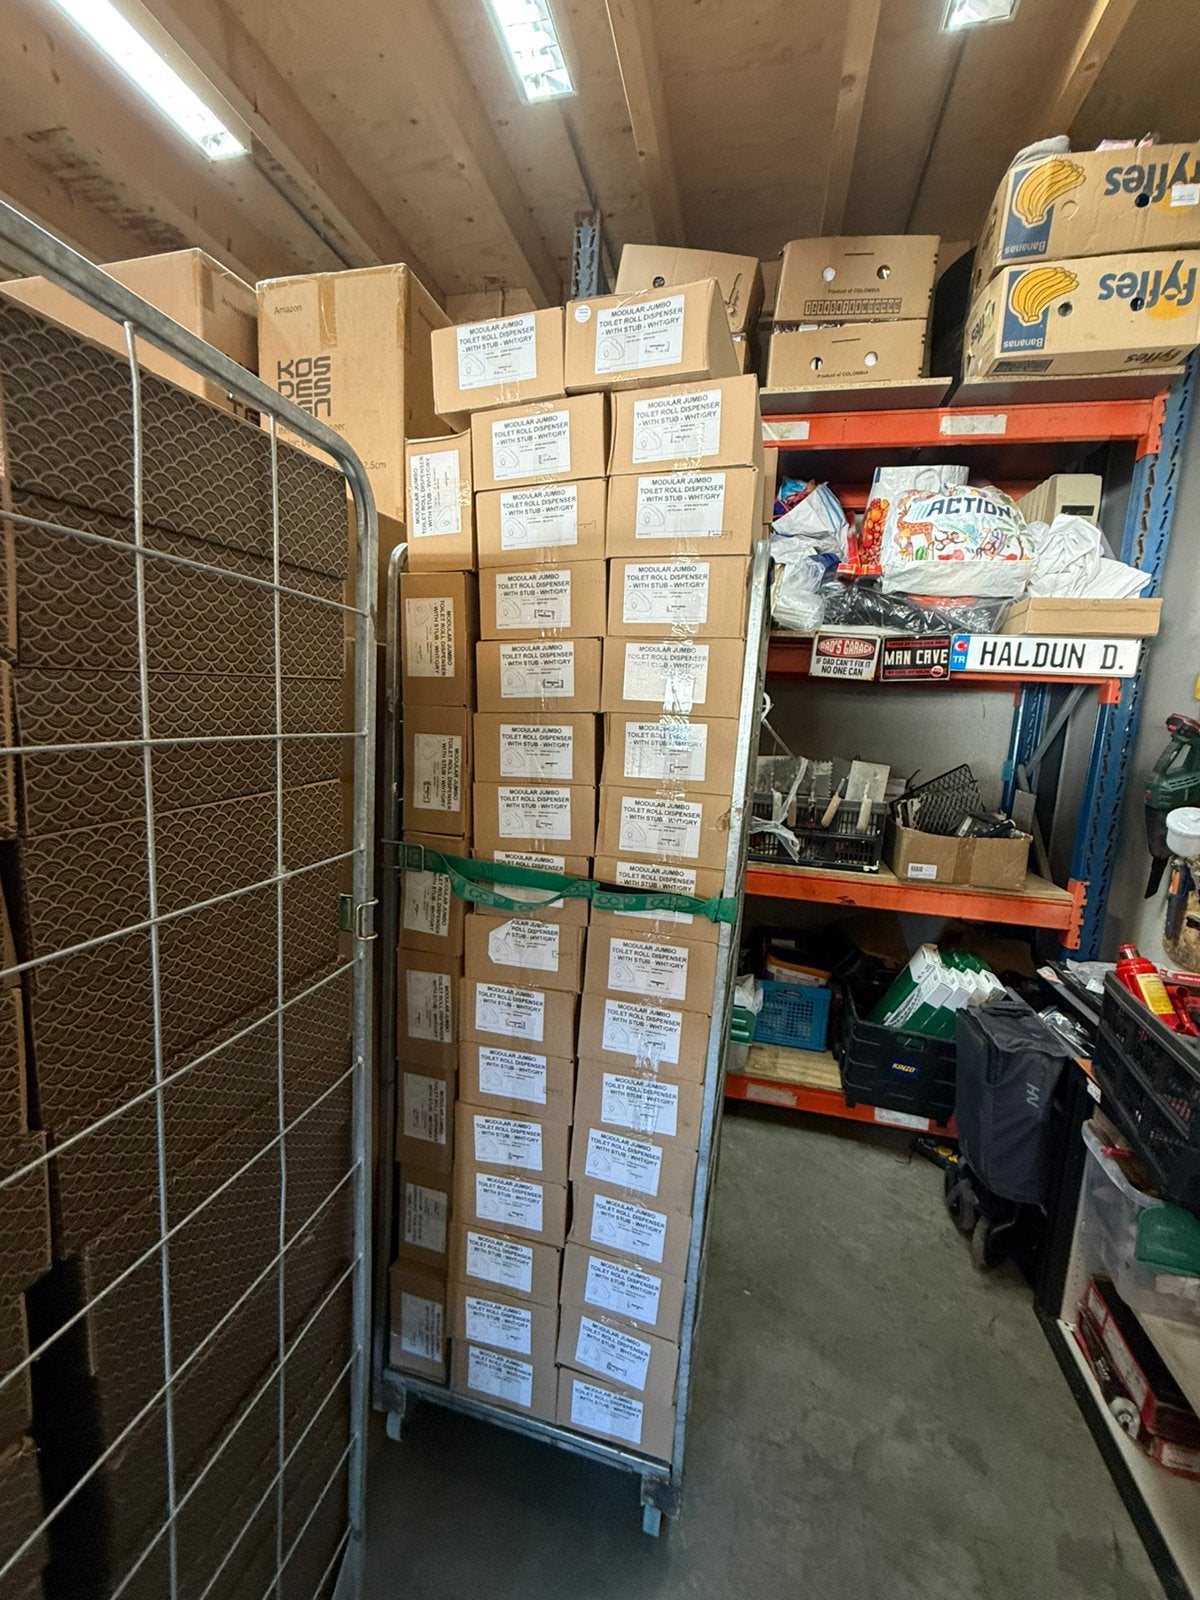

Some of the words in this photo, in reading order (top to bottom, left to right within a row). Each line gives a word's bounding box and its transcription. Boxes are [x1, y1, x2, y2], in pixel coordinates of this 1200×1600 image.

[1005, 241, 1046, 254] Bananas
[274, 304, 302, 314] Amazon
[611, 305, 644, 317] MODULAR
[646, 300, 671, 311] JUMBO
[599, 318, 622, 328] TOILET
[624, 314, 641, 323] ROLL
[643, 307, 682, 320] DISPENSER
[469, 323, 500, 334] MODULAR
[501, 320, 523, 329] JUMBO
[605, 327, 621, 335] WITH
[624, 323, 641, 332] STUB
[647, 316, 679, 328] WHT/GRY
[459, 335, 480, 344] TOILET
[482, 332, 497, 341] ROLL
[499, 326, 533, 338] DISPENSER
[465, 344, 481, 352] WITH
[483, 341, 498, 349] STUB
[503, 335, 531, 346] WHT/GRY
[1004, 337, 1043, 348] Bananas
[278, 356, 331, 379] KOS
[278, 377, 331, 398] DES
[649, 398, 682, 408] MODULAR
[684, 394, 709, 403] JUMBO
[637, 409, 660, 418] TOILET
[662, 407, 679, 415] ROLL
[681, 402, 720, 413] DISPENSER
[504, 419, 534, 429] MODULAR
[535, 415, 557, 424] JUMBO
[643, 418, 660, 426] WITH
[662, 416, 679, 424] STUB
[685, 411, 717, 421] WHT/GRY
[494, 429, 515, 438] TOILET
[516, 427, 531, 435] ROLL
[534, 421, 567, 432] DISPENSER
[517, 435, 532, 443] STUB
[537, 429, 566, 439] WHT/GRY
[684, 484, 723, 492] DISPENSER
[502, 501, 523, 509] TOILET
[542, 496, 575, 505] DISPENSER
[513, 492, 542, 500] MODULAR
[545, 504, 573, 513] WHT/GRY
[927, 497, 1012, 518] ACTION
[884, 651, 911, 665] MAN
[916, 649, 948, 664] CAVE
[953, 656, 965, 664] TR
[980, 641, 1086, 669] HALDUN
[1100, 645, 1123, 670] D.
[821, 666, 831, 674] NO
[833, 667, 847, 675] ONE
[848, 668, 862, 676] CAN
[612, 947, 633, 955] TOILET
[652, 952, 686, 962] DISPENSER
[623, 942, 653, 950] MODULAR
[655, 946, 676, 954] JUMBO
[487, 986, 513, 995] MODULAR
[478, 991, 496, 999] TOILET
[513, 997, 543, 1006] DISPENSER
